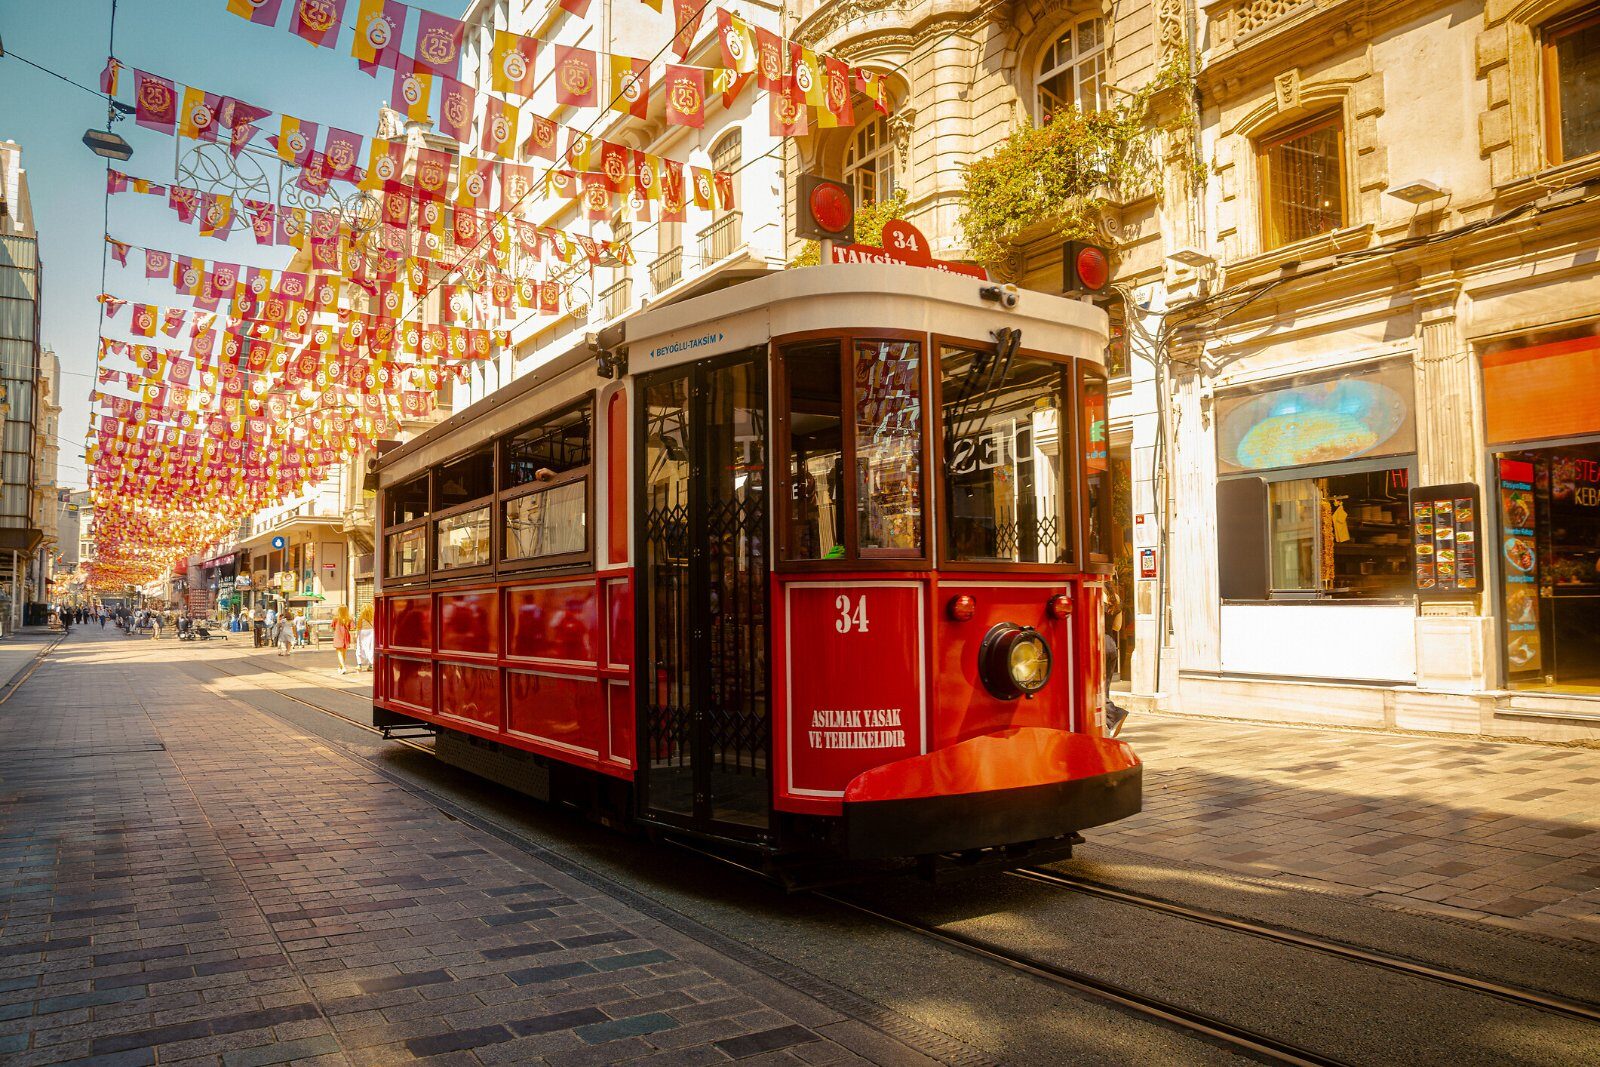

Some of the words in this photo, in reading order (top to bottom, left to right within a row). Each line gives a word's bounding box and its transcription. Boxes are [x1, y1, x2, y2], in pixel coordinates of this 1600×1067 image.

[308, 0, 327, 22] 25
[429, 41, 447, 57] 25
[570, 70, 584, 86] 25
[147, 87, 163, 103] 25
[678, 89, 693, 106] 25
[781, 99, 796, 115] 25
[334, 149, 348, 163] 25
[425, 169, 438, 184] 25
[591, 190, 603, 204] 25
[893, 231, 918, 251] 34
[834, 246, 906, 265] TAKSİ
[496, 285, 506, 296] 25
[547, 289, 556, 300] 25
[1575, 487, 1600, 506] KEB
[835, 594, 869, 634] 34
[811, 710, 861, 728] ASILMAK
[863, 709, 901, 727] YASAK
[808, 730, 823, 748] VE
